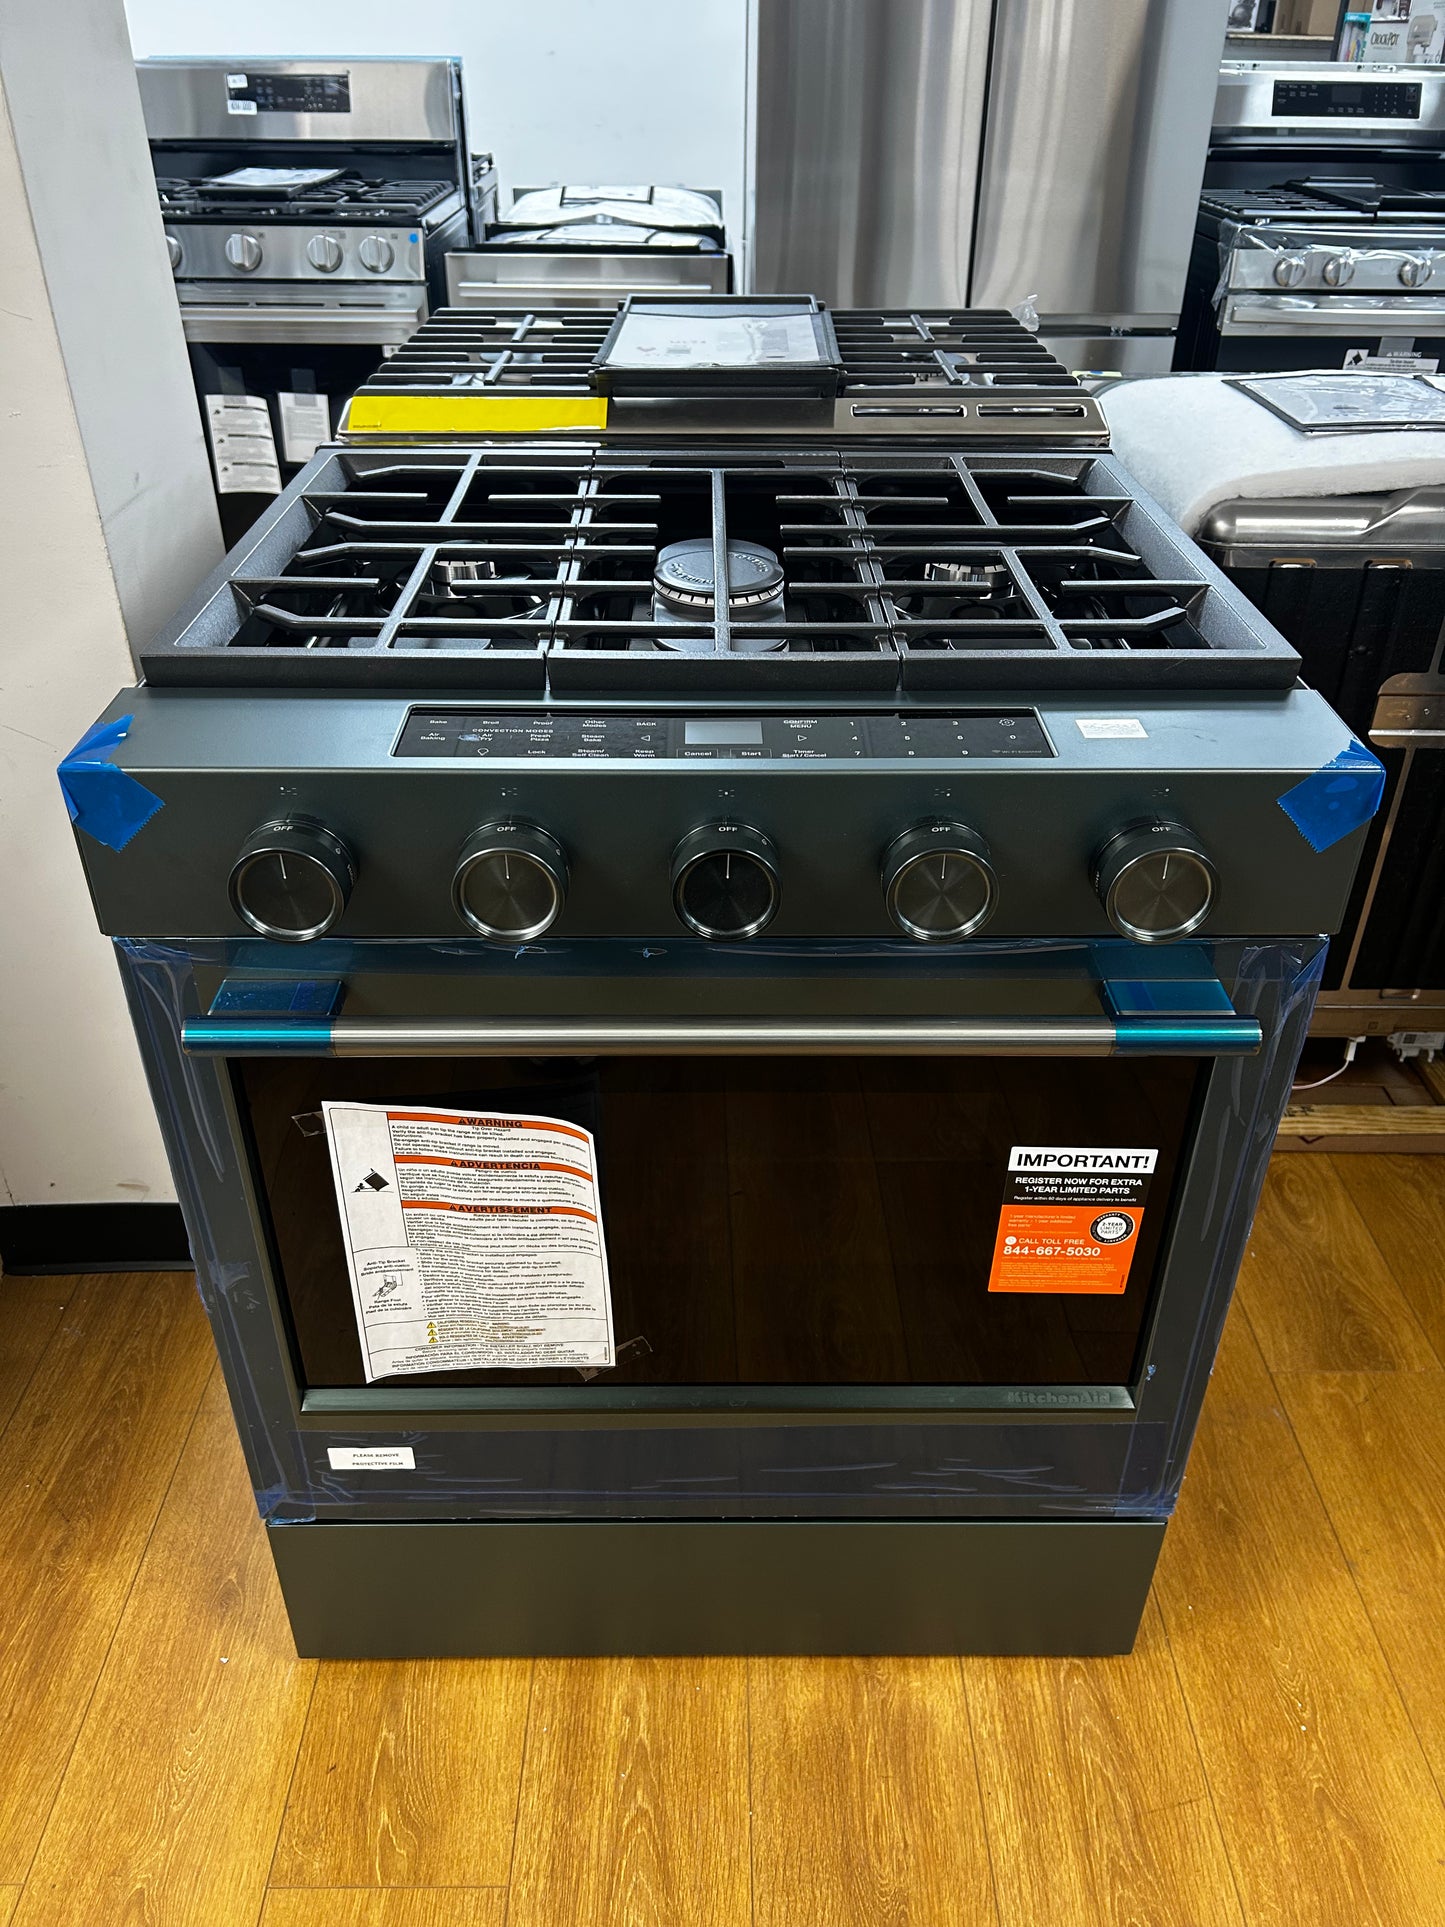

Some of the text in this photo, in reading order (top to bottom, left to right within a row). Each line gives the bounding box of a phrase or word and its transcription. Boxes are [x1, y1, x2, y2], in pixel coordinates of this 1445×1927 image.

[467, 1118, 522, 1128] WARNING
[460, 1161, 541, 1170] ADVERTENCIA
[1016, 1153, 1150, 1169] IMPORTANT!
[1015, 1177, 1062, 1185] REGISTER
[1110, 1178, 1143, 1186] EXTRA
[1059, 1186, 1097, 1194] LIMITED
[459, 1205, 552, 1214] AVERTISSEMENT
[1003, 1246, 1101, 1256] 844-667-5030
[1007, 1391, 1111, 1403] KitchenAid
